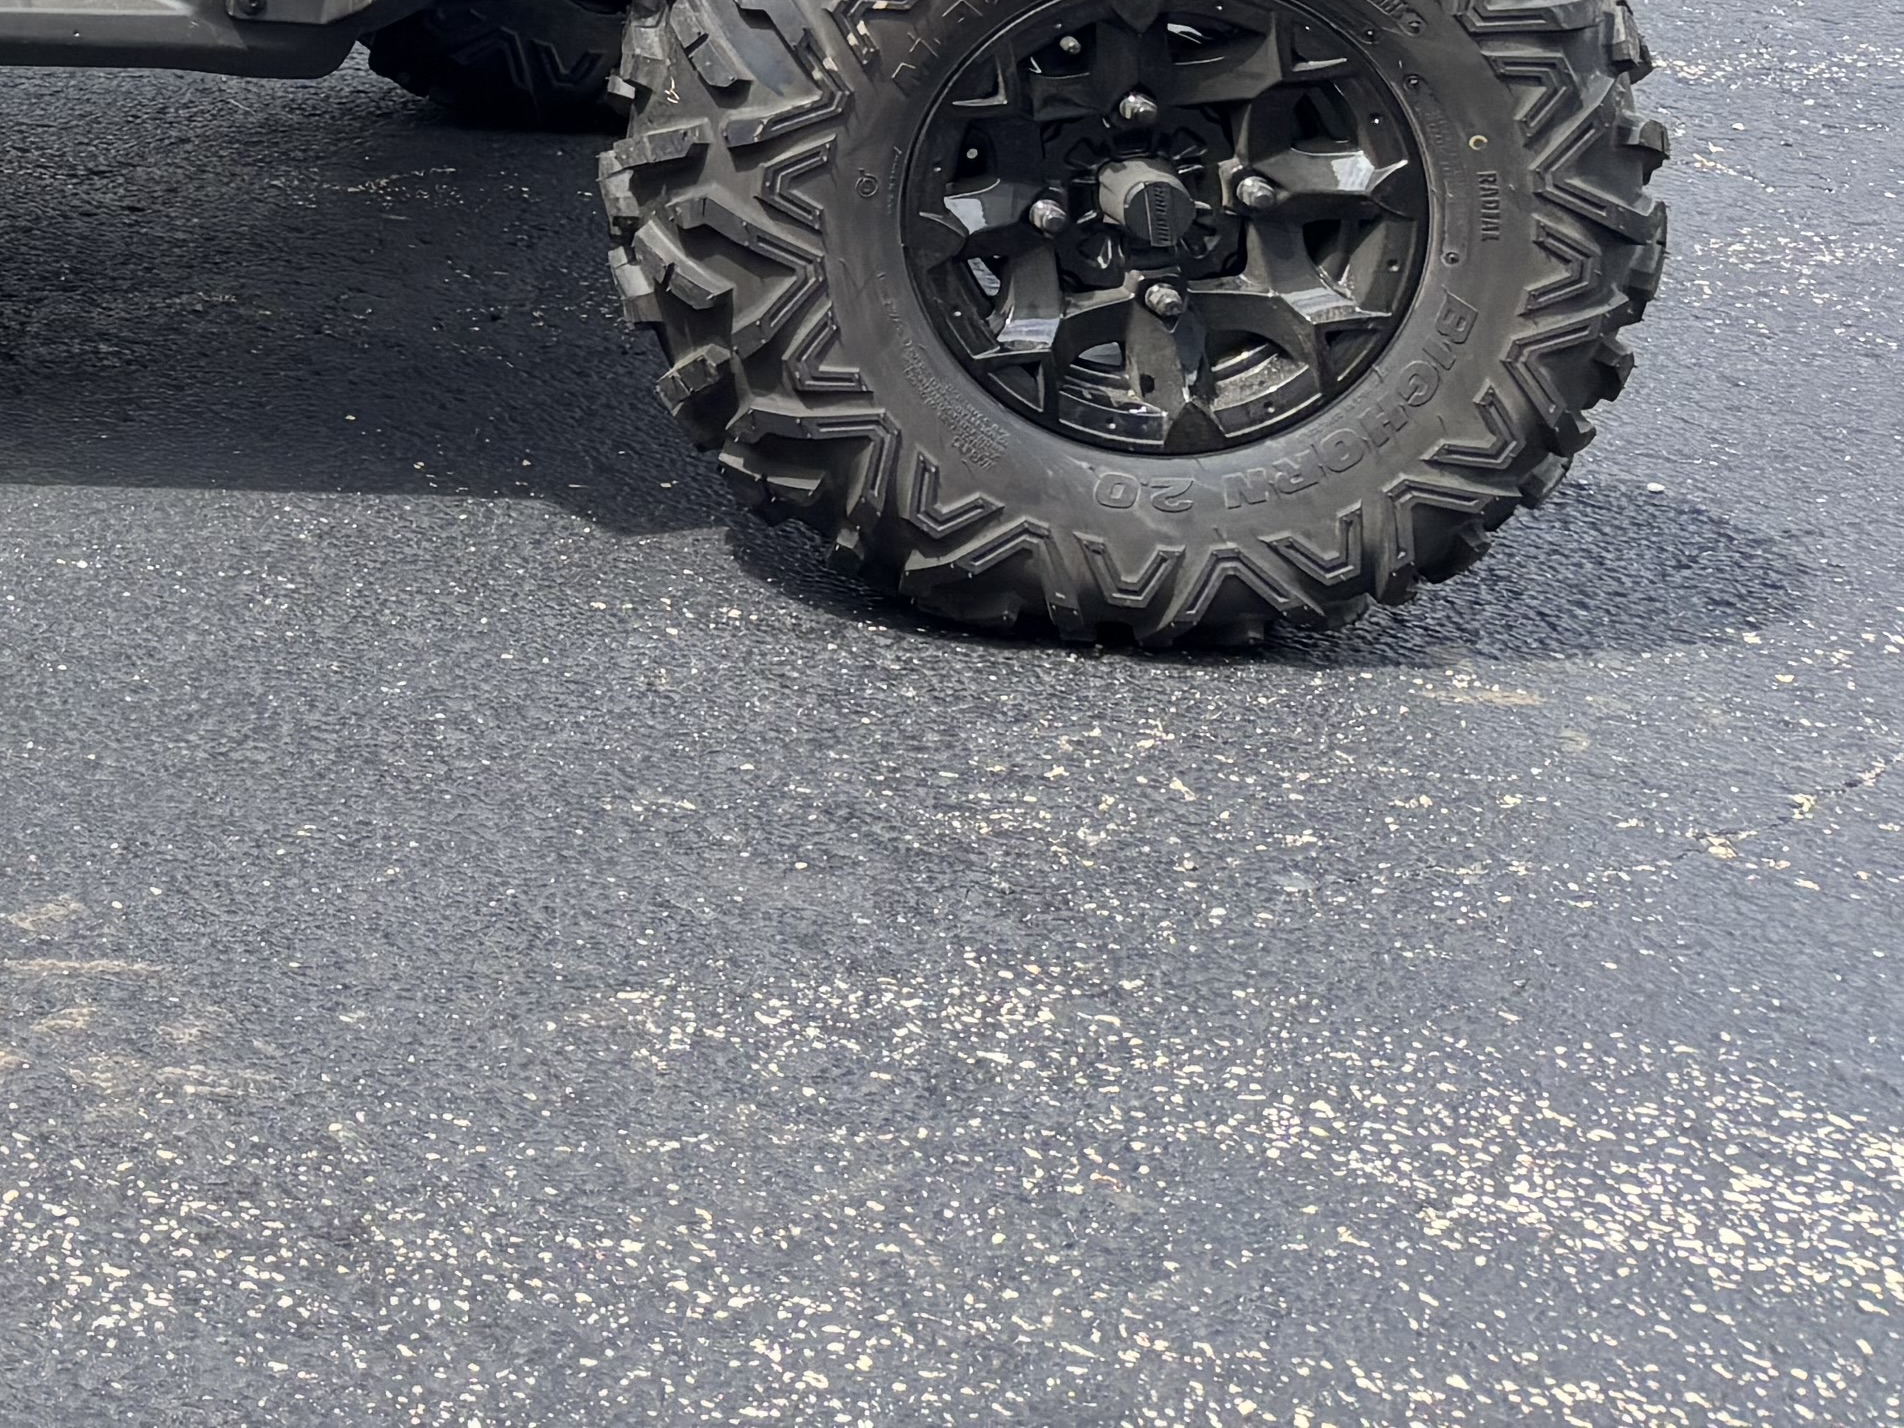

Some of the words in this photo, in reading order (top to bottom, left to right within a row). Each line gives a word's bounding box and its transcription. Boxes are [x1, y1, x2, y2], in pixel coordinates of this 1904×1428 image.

[1475, 171, 1500, 241] RADIAL
[1221, 284, 1479, 509] BIGHORN
[1095, 472, 1194, 513] 2.0
